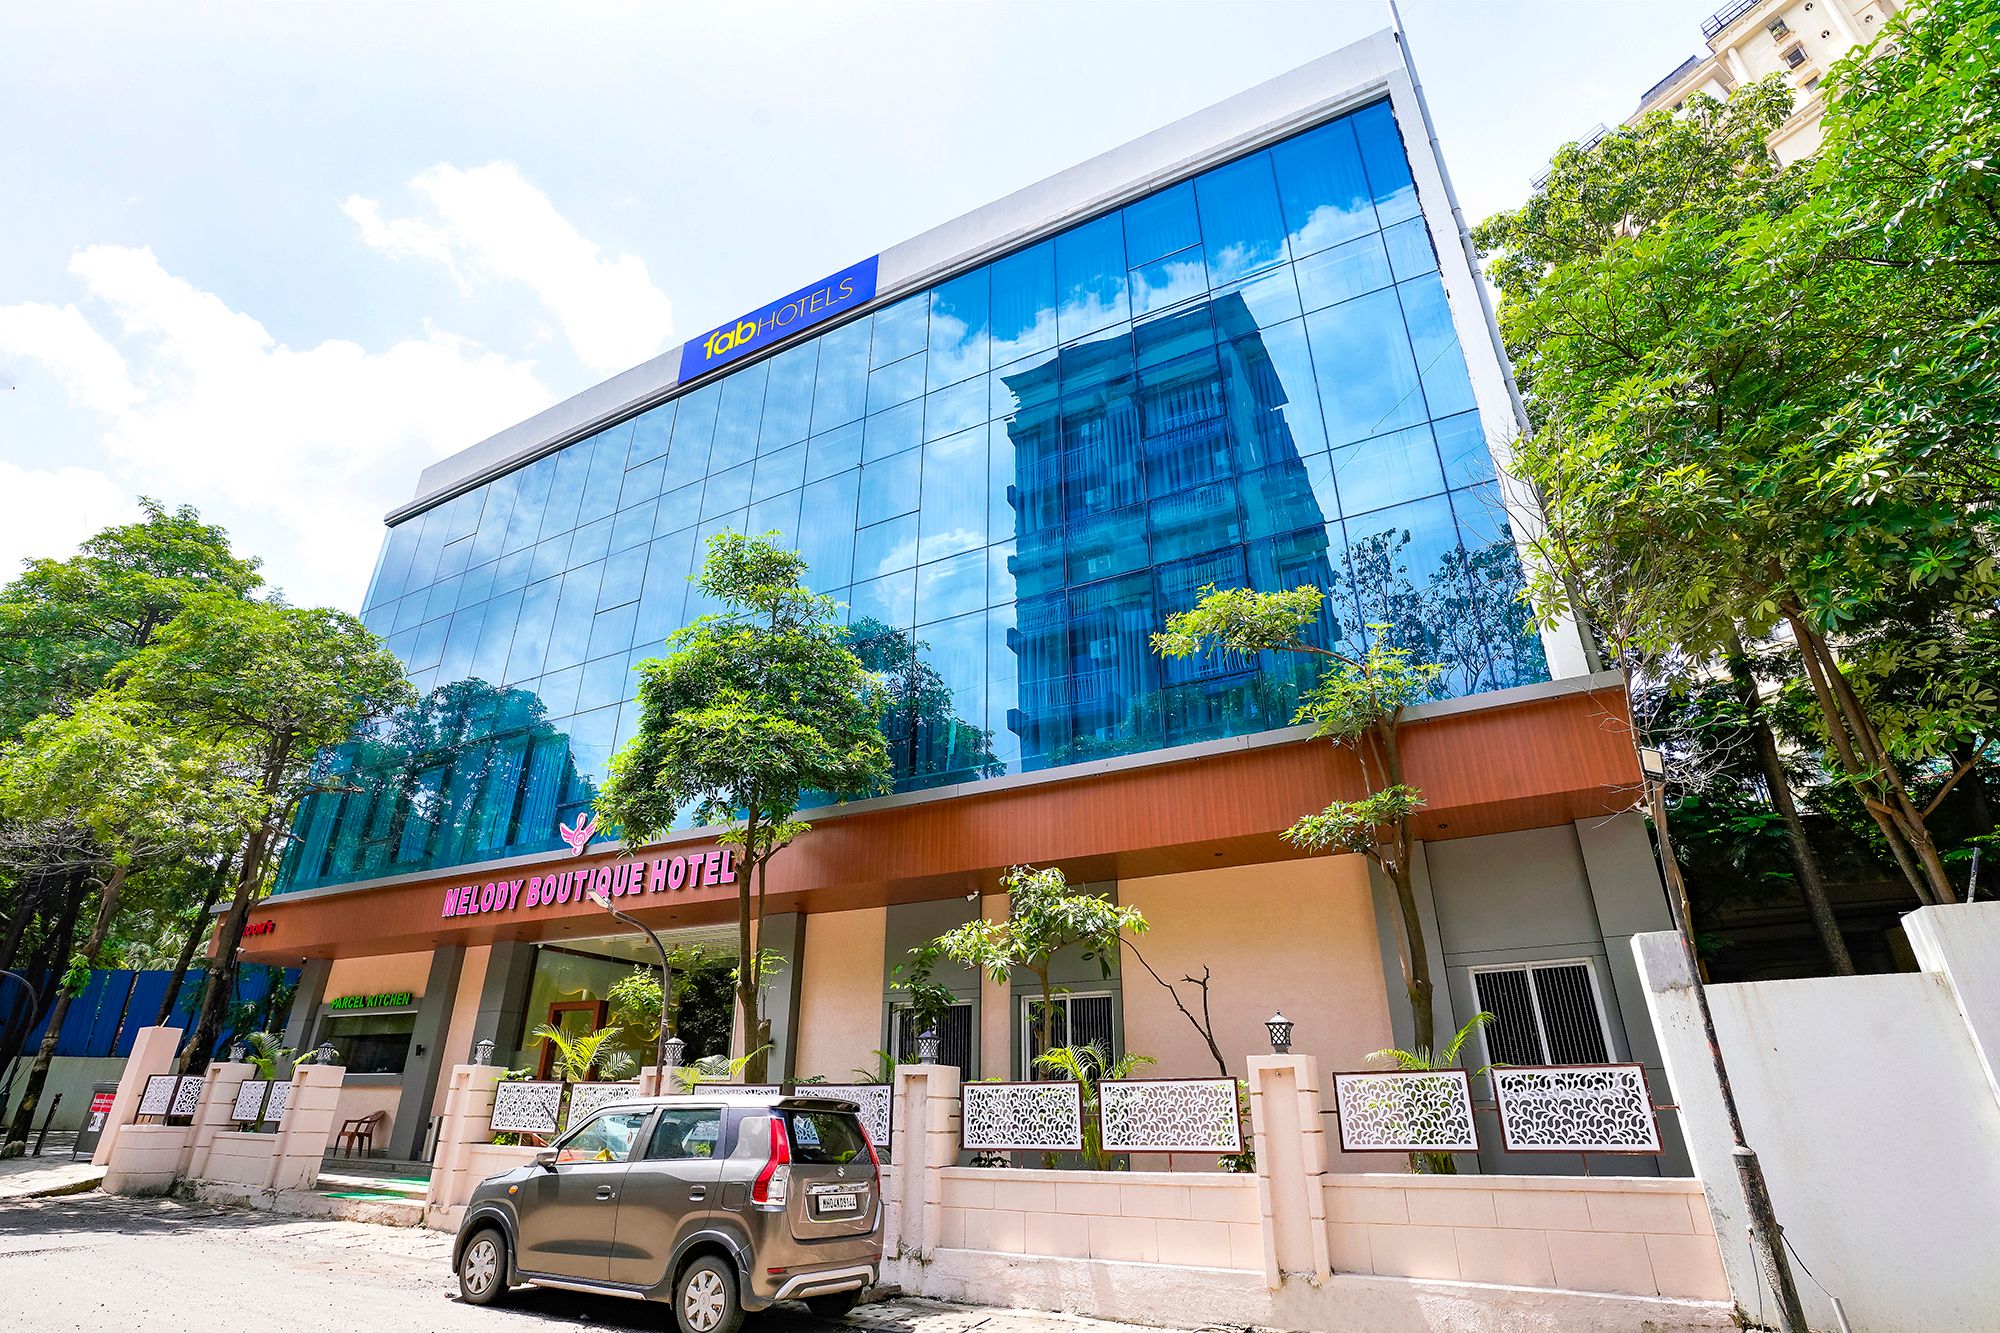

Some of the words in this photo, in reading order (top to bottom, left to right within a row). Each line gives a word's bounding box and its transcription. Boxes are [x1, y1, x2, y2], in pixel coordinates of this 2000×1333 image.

[441, 880, 523, 917] MELODY
[526, 862, 645, 907] BOUTIQUE
[650, 850, 735, 892] HOTEL
[331, 995, 365, 1009] PARCEL
[367, 992, 411, 1007] KITCHEN
